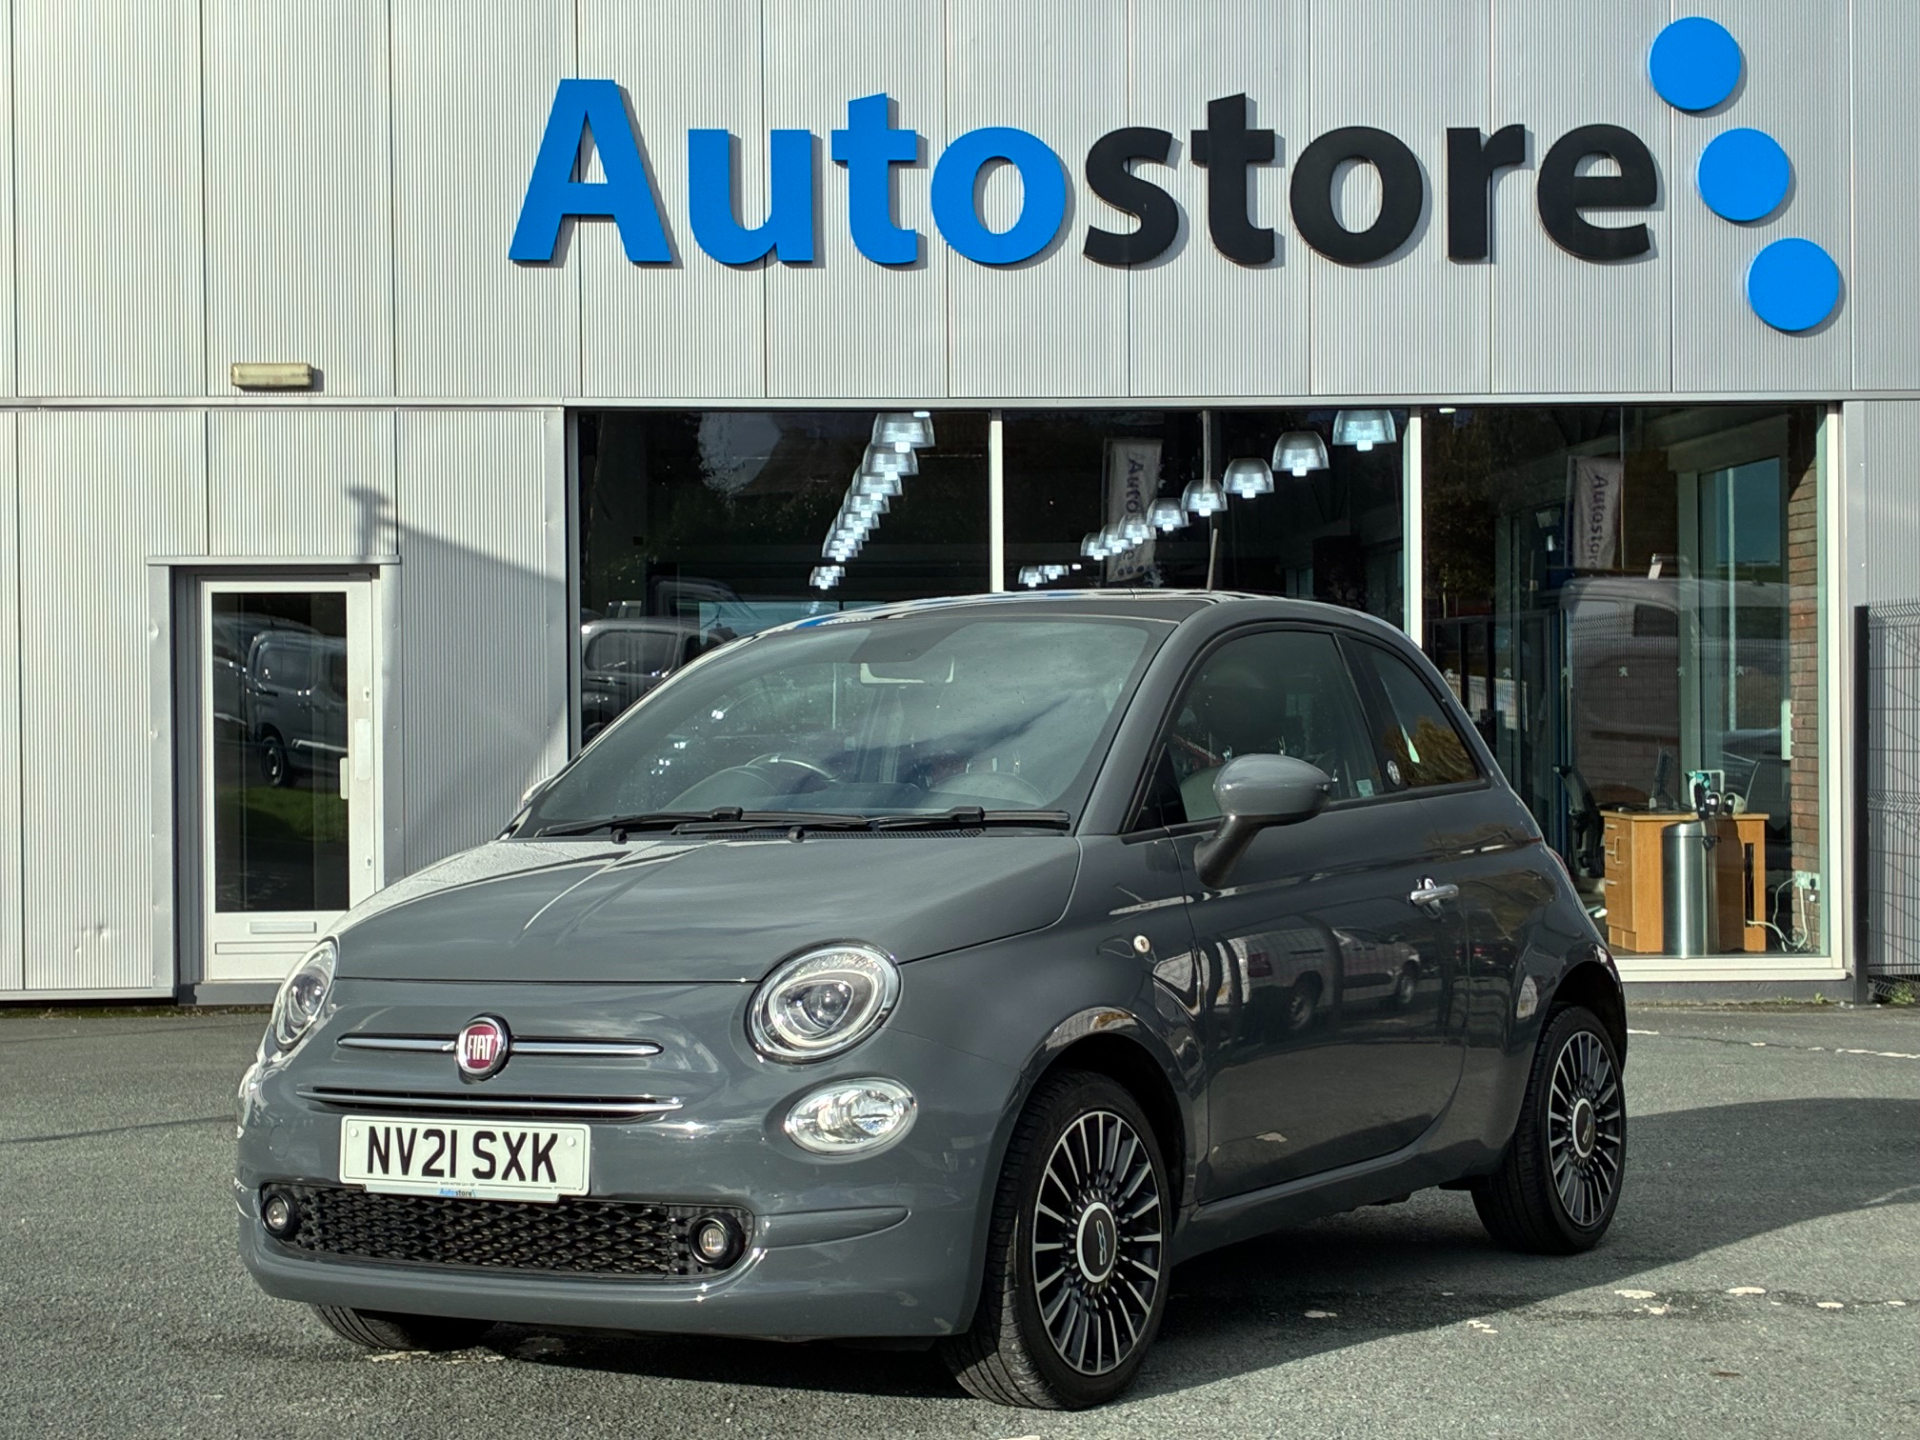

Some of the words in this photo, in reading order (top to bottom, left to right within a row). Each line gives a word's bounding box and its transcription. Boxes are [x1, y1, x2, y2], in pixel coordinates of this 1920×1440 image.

[508, 79, 1658, 264] Autostore
[467, 1034, 495, 1060] FIAT
[367, 1125, 457, 1178] NV21
[472, 1130, 558, 1183] SXK
